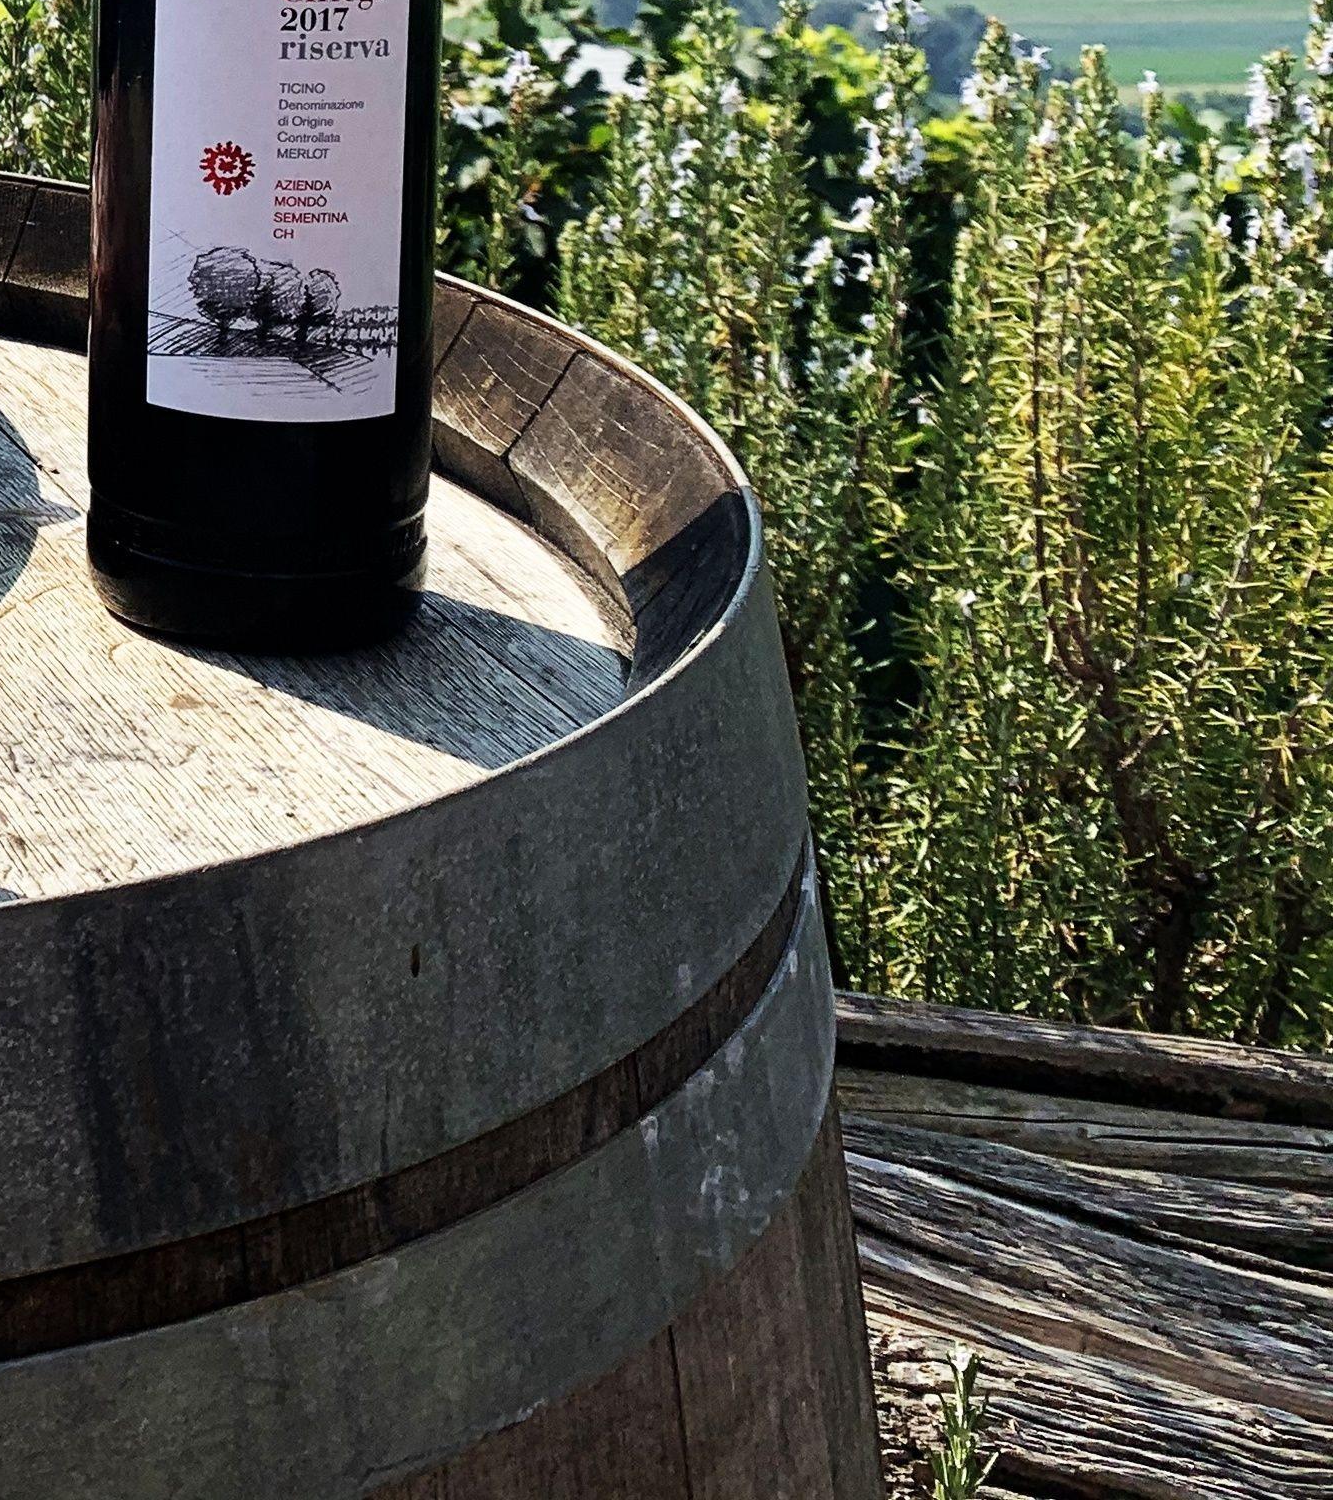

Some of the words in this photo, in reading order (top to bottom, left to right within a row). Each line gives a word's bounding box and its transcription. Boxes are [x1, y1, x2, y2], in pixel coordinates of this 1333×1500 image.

[280, 7, 349, 32] 2017
[279, 34, 391, 60] riserva
[279, 83, 325, 94] TICINO
[278, 99, 365, 111] Denominazione
[277, 116, 289, 127] di
[291, 116, 334, 130] Origine
[277, 132, 341, 143] Controllata
[276, 148, 330, 159] MERLOT
[274, 180, 332, 191] AZIENDA
[273, 212, 348, 223] SEMENTINA
[273, 228, 294, 239] CH
